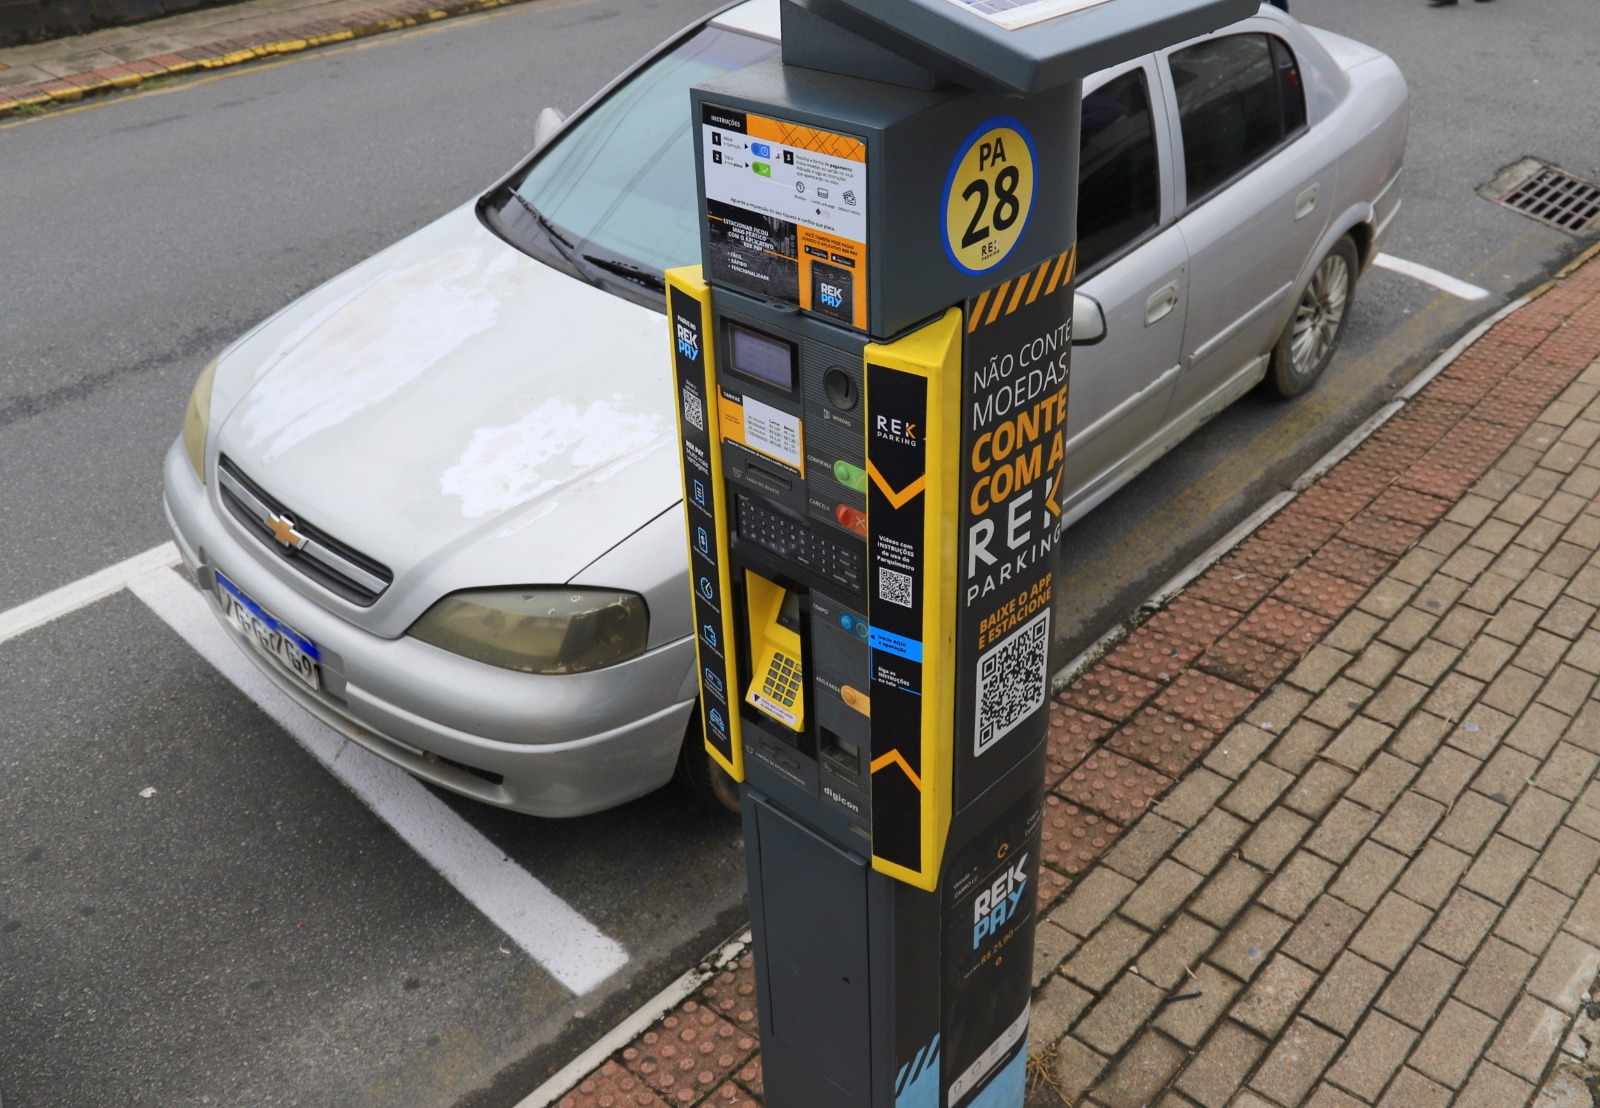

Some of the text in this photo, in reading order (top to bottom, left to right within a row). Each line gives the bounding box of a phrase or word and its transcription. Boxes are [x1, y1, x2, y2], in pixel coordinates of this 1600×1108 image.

[711, 115, 740, 128] INSTRUÇÕES
[979, 137, 1006, 172] PA
[962, 165, 1020, 250] 28
[724, 218, 769, 236] ESTACIONAR FICOU
[733, 227, 767, 241] MAIS PRÁTICO
[746, 236, 774, 249] APLICATIVO
[730, 251, 742, 260] FÁCIL
[731, 258, 747, 267] RÁPIDO
[731, 265, 770, 281] FUNCIONALIDADE
[821, 283, 842, 299] REK
[821, 294, 842, 308] PAY
[677, 324, 699, 350] REK
[678, 338, 699, 361] PAY
[973, 317, 1072, 394] NÃO CONTE
[724, 392, 740, 403] TARIFAS
[973, 352, 1069, 431] MOEDAS.
[832, 414, 852, 427] MOEDAS
[877, 415, 916, 439] REK
[971, 383, 1068, 473] CONTE
[877, 431, 916, 447] PARKING
[807, 454, 832, 470] CONFIRMA
[970, 429, 1064, 516] COM A
[809, 498, 830, 512] CANCELA
[967, 464, 1064, 580] REK
[878, 542, 915, 557] INSTRUÇÕES
[967, 522, 1061, 608] PARKING
[813, 604, 829, 615] TEMPO
[980, 572, 1052, 634] BAIXE O APP
[978, 586, 1052, 650] E ESTACIONE
[883, 642, 907, 653] operação
[893, 638, 906, 647] AQUI
[878, 666, 889, 674] Siga
[816, 676, 840, 692] REGULARIZA
[878, 672, 910, 686] INSTRUÇÕES
[824, 787, 859, 813] digicon
[974, 852, 1028, 925] REK
[973, 879, 1026, 950] PAY
[981, 951, 992, 965] R$
